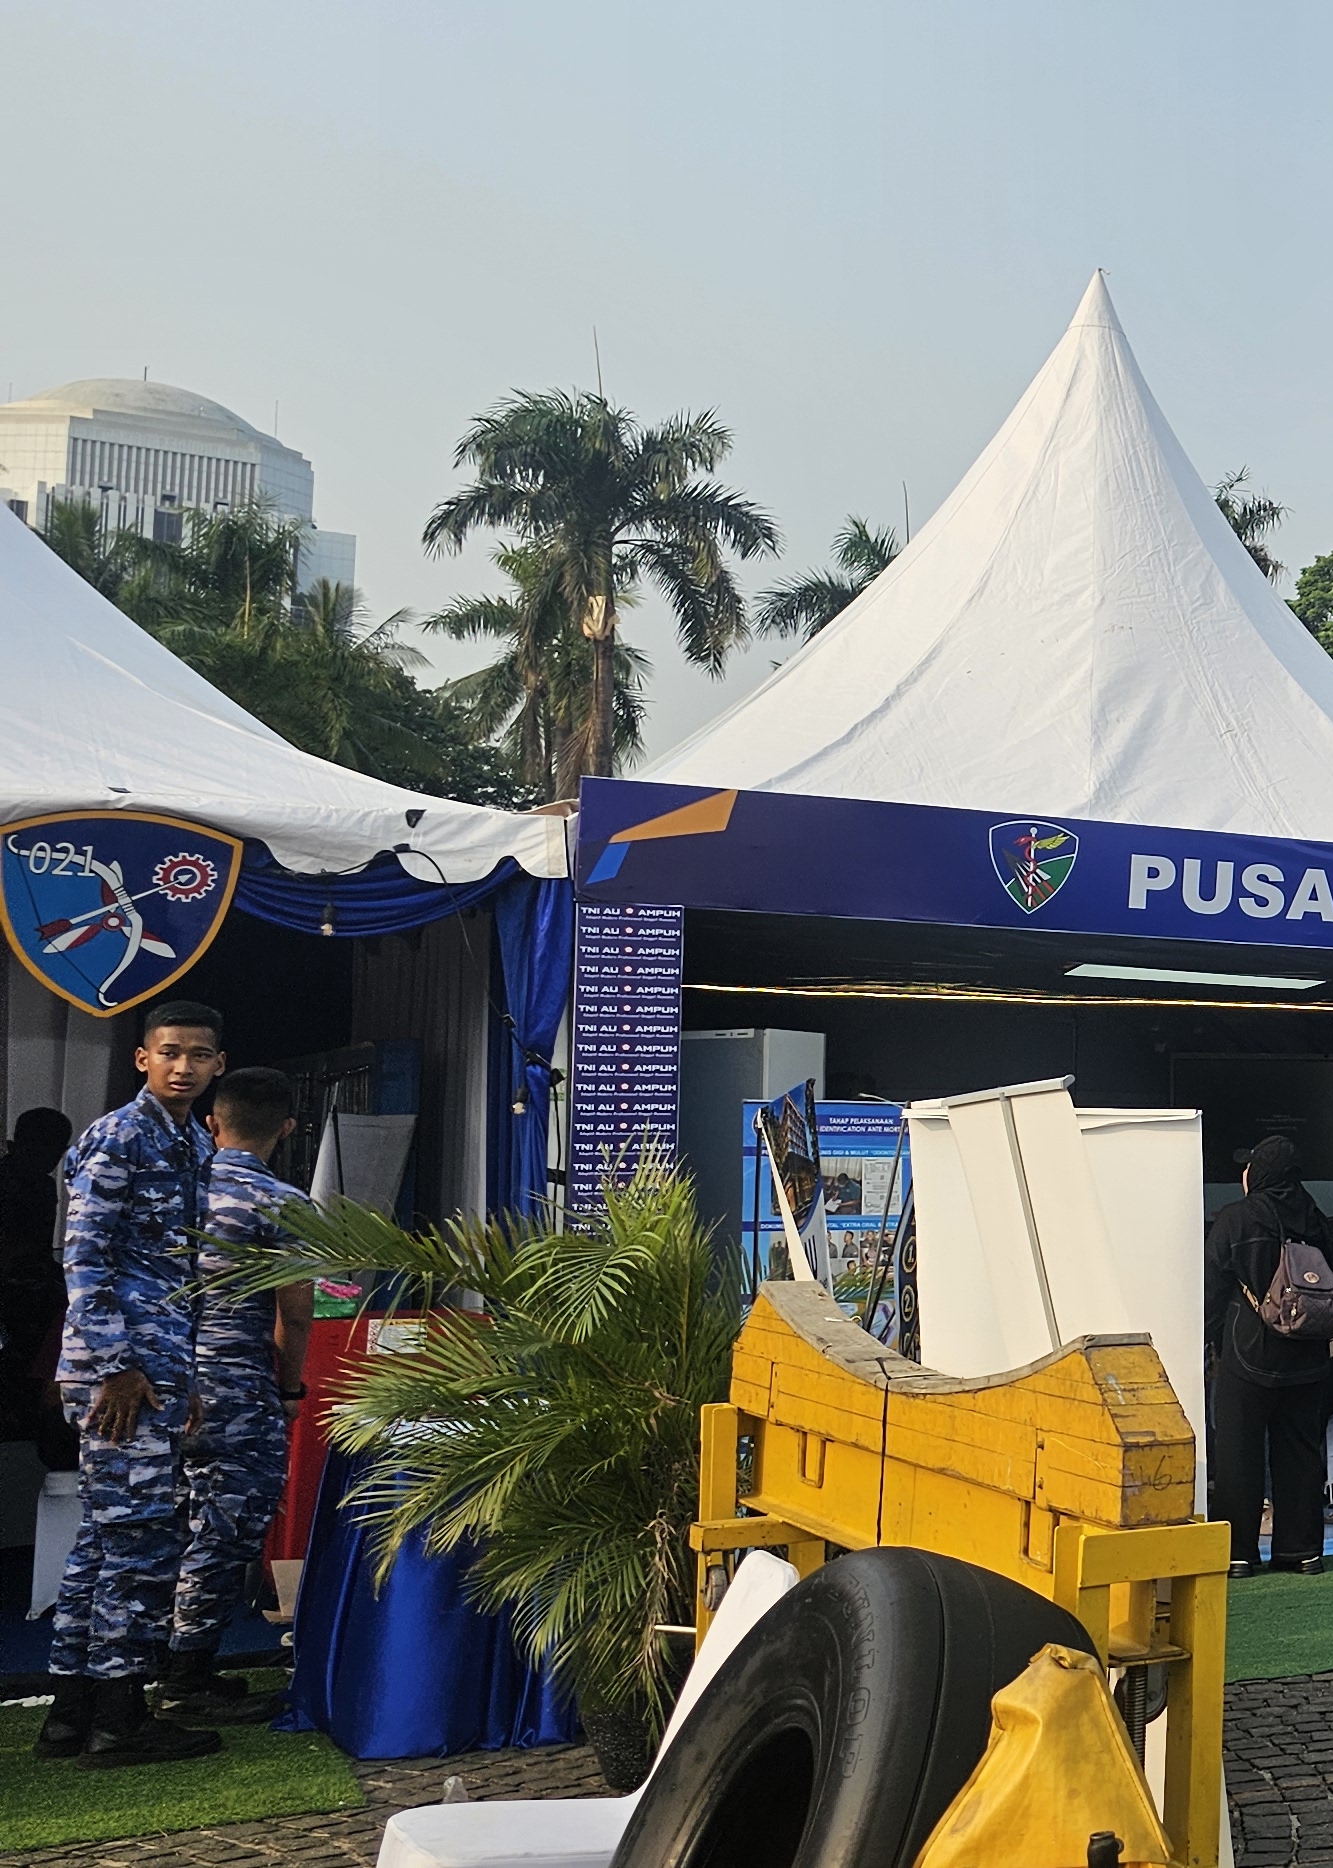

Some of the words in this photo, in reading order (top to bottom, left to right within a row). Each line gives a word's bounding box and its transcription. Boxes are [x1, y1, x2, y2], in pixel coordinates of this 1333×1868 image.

[29, 841, 96, 877] 021
[638, 909, 680, 917] AMPUH
[637, 948, 679, 956] AMPUH
[634, 1046, 676, 1054] AMPUH
[633, 1085, 675, 1093] AMPUH
